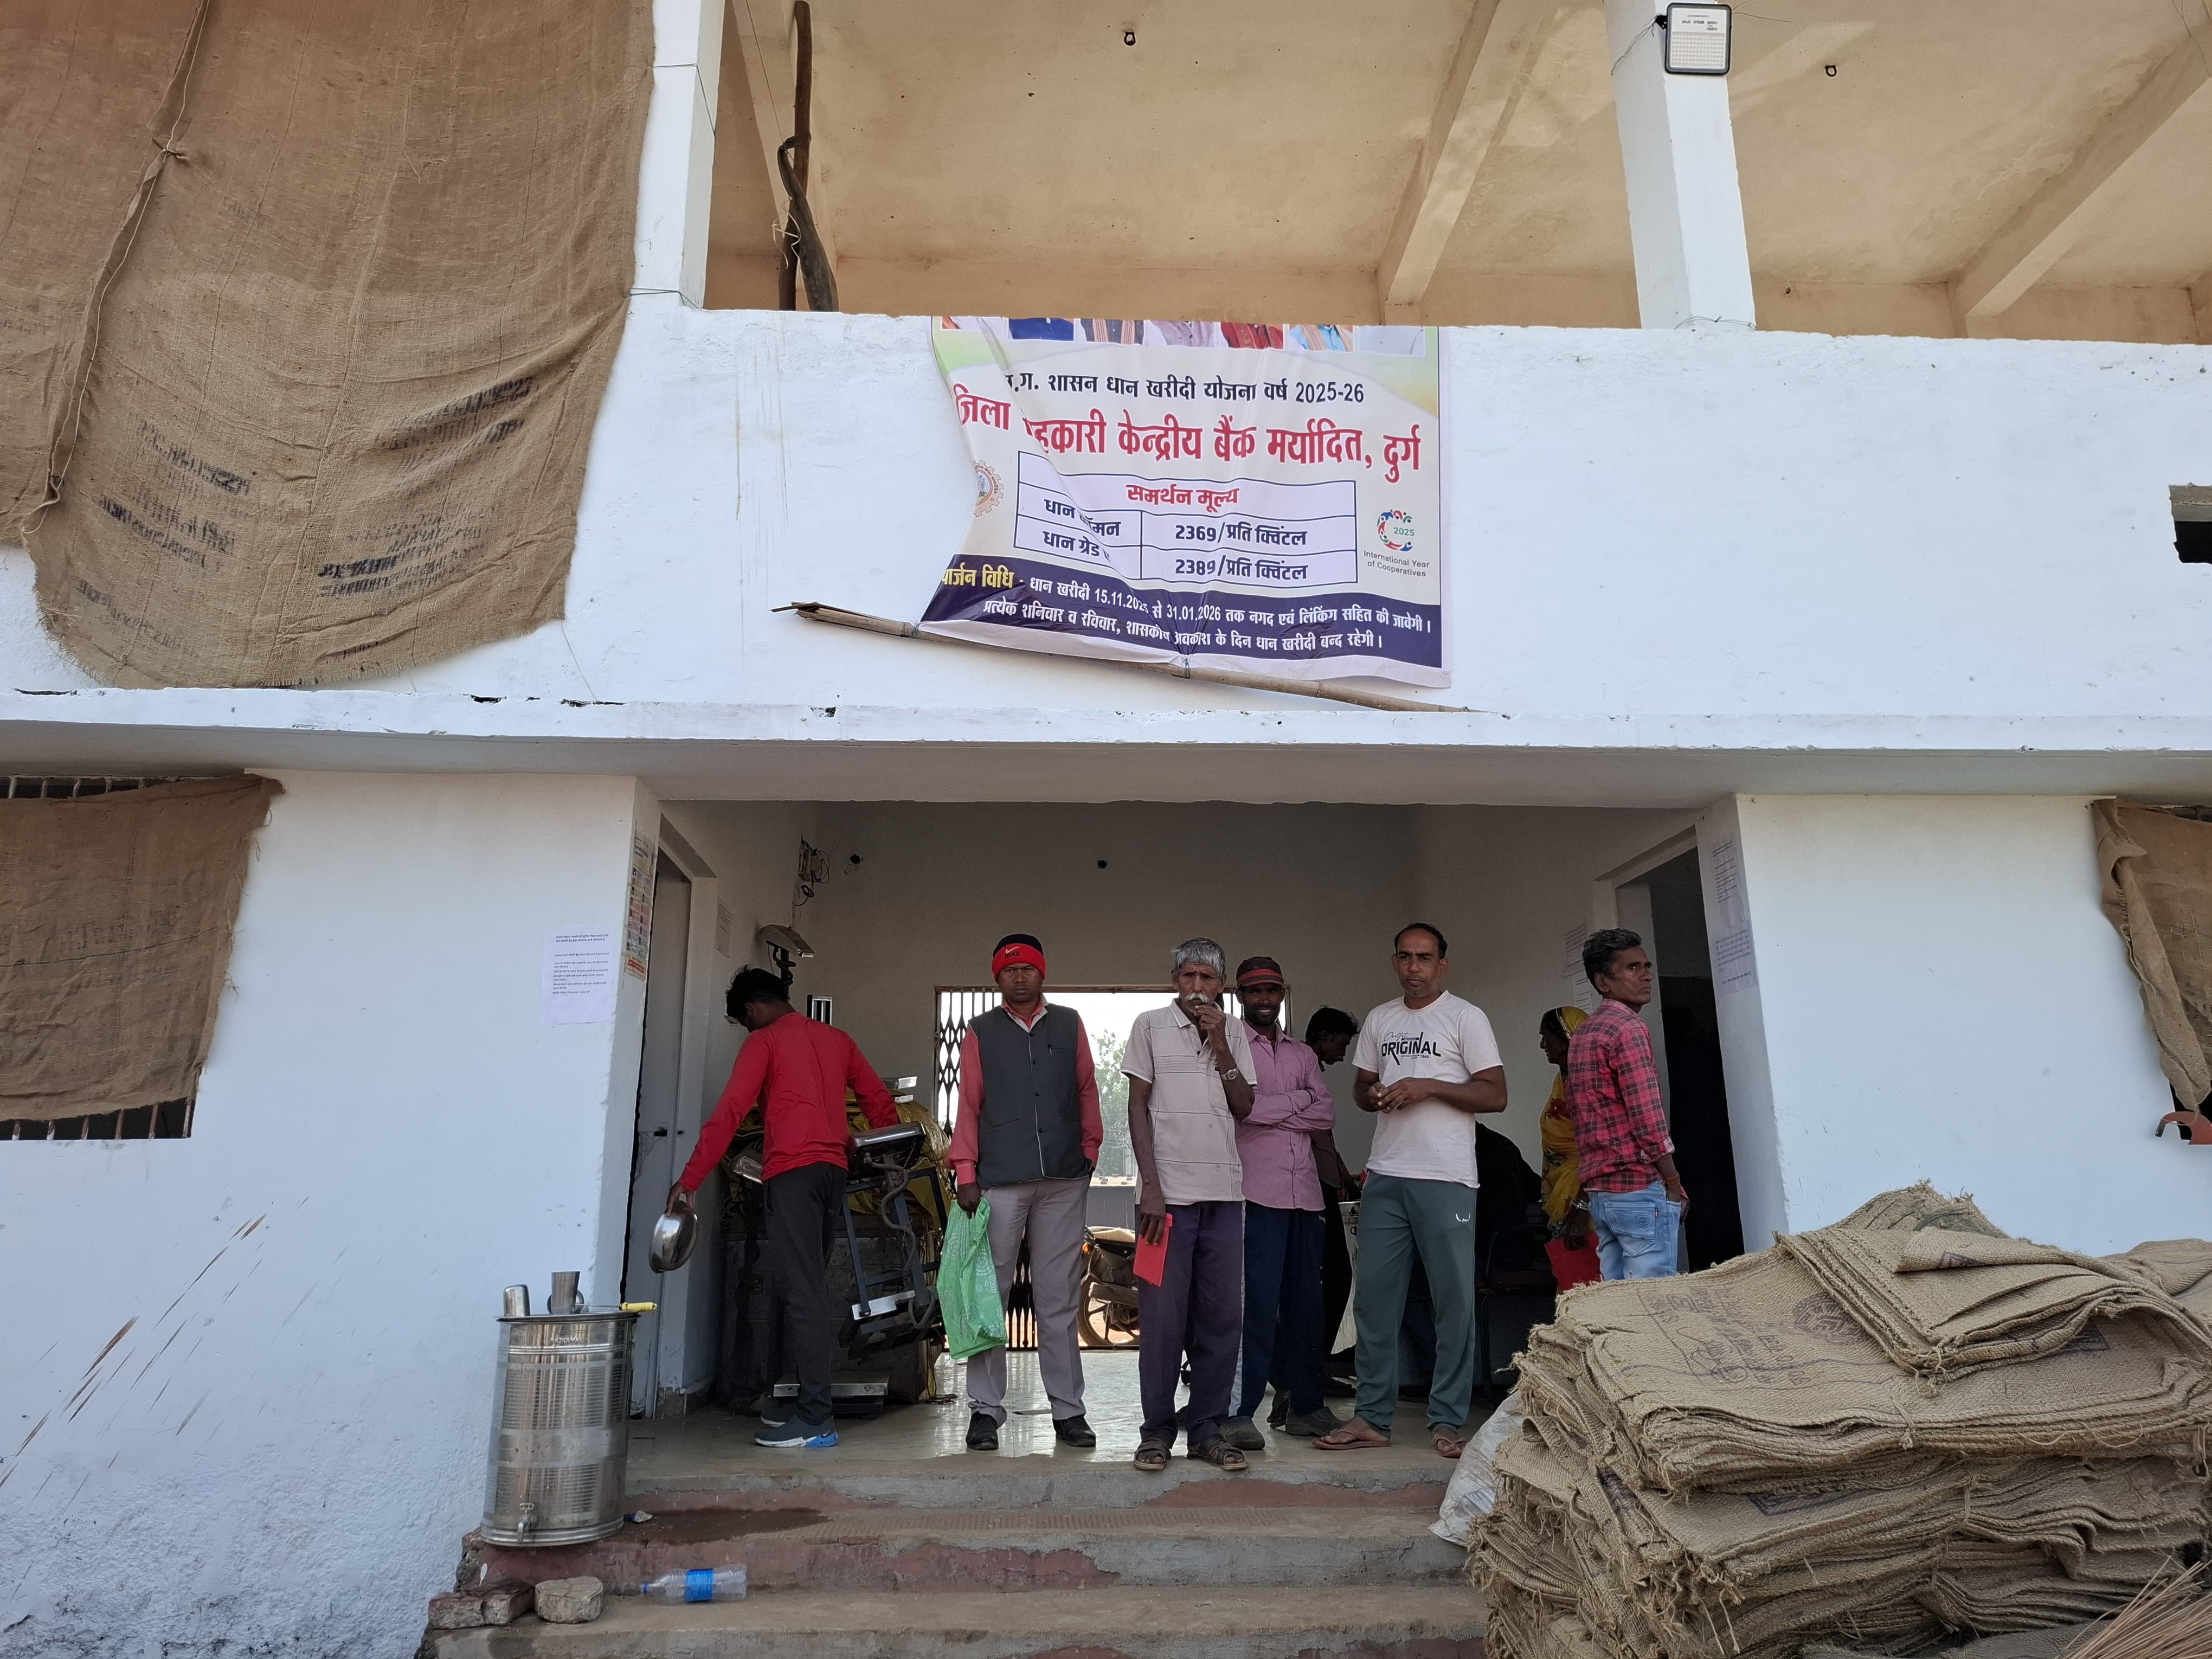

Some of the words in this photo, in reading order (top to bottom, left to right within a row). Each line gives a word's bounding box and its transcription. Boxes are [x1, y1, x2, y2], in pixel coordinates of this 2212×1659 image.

[1049, 374, 1098, 393] शासन
[1107, 376, 1138, 397] धान
[1147, 374, 1196, 400] खरीदी
[1203, 375, 1257, 401] योजना
[1264, 378, 1288, 401] वर्ष
[1295, 382, 1364, 403] 2025-26
[953, 383, 1011, 430] जिला
[1022, 408, 1107, 454] हकारी
[1117, 409, 1203, 461] केन्द्रीय
[1213, 415, 1257, 462] बैंक
[1266, 417, 1372, 469] मर्यादित,
[1382, 424, 1420, 483] दुर्ग
[1044, 499, 1076, 519] धान
[1126, 484, 1193, 505] समर्थन
[1196, 488, 1239, 513] मूल्य
[1043, 531, 1076, 551] धान
[1078, 536, 1100, 556] ग्रेड
[1255, 524, 1308, 545] क्विंटल
[1394, 527, 1414, 537] 2025
[1255, 560, 1308, 580] क्विंटल
[1364, 550, 1409, 566] International
[1412, 560, 1430, 568] Year
[1377, 562, 1426, 577] Cooperatives
[982, 564, 1014, 588] विधि
[1030, 577, 1053, 594] धान
[1057, 580, 1090, 600] खरीदी
[1095, 588, 1148, 614] 15.11.2025
[1152, 600, 1162, 619] से
[1167, 604, 1220, 621] 31.01.2026
[1225, 609, 1245, 622] तक
[1249, 610, 1274, 626] नगद
[1278, 608, 1294, 625] एवं
[1299, 605, 1338, 624] लिंकिंग
[1342, 603, 1372, 622] सहित
[1376, 607, 1389, 625] की
[1393, 612, 1423, 632] जावेगी
[983, 596, 1018, 616] प्रत्येक
[1021, 600, 1064, 622] शनिवार
[1068, 610, 1077, 624] व
[1081, 609, 1121, 634] रविवार,
[1215, 628, 1227, 645] के
[1231, 630, 1251, 648] दिन
[1256, 636, 1277, 651] धान
[1282, 632, 1316, 651] खरीदी
[1320, 633, 1343, 648] बन्द
[1347, 628, 1373, 647] रहेगी
[1381, 1031, 1441, 1065] ORIGINAL
